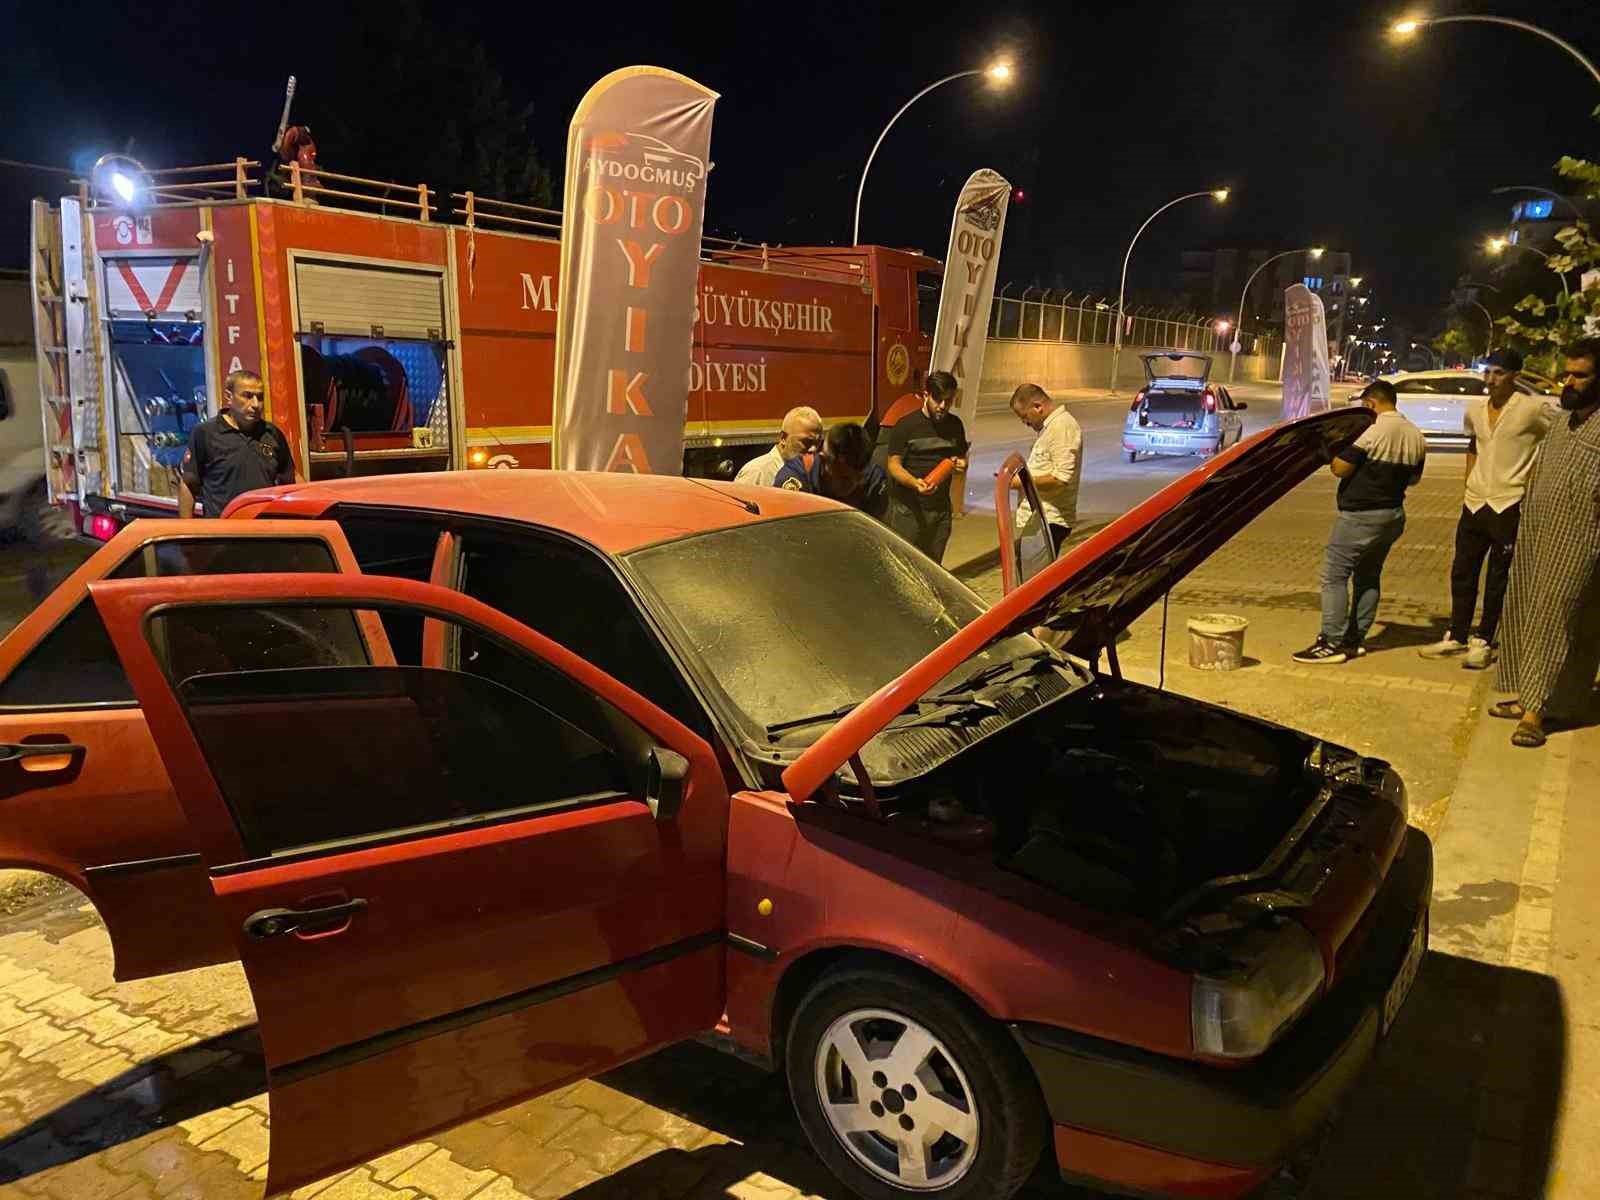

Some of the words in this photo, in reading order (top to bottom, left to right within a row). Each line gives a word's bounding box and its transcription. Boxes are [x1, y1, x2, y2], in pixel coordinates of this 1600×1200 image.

[583, 158, 696, 192] AYDOĞMUŞ
[583, 186, 693, 238] OTO
[957, 229, 995, 261] OTO
[519, 272, 558, 312] M
[688, 354, 768, 392] DİYESİ
